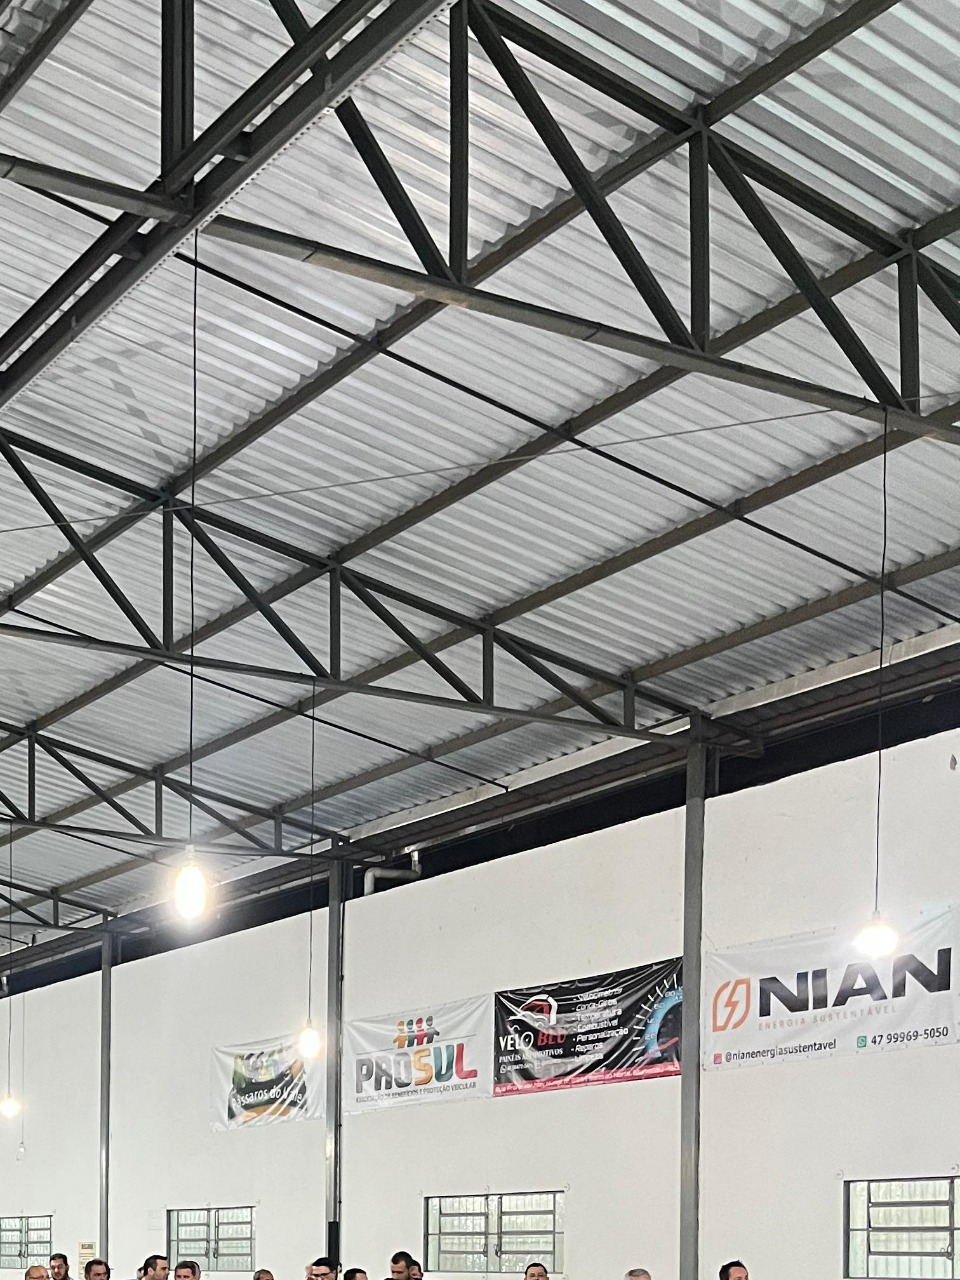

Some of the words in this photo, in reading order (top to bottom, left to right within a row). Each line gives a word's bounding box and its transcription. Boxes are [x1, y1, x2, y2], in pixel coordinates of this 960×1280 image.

[759, 948, 952, 1017] NIAN
[759, 1017, 806, 1031] ENERGIA
[871, 1034, 883, 1045] 47
[886, 1026, 949, 1044] 99969-5050
[725, 1038, 836, 1062] @nianenergiasustentavel
[356, 1043, 478, 1094] PROSUL
